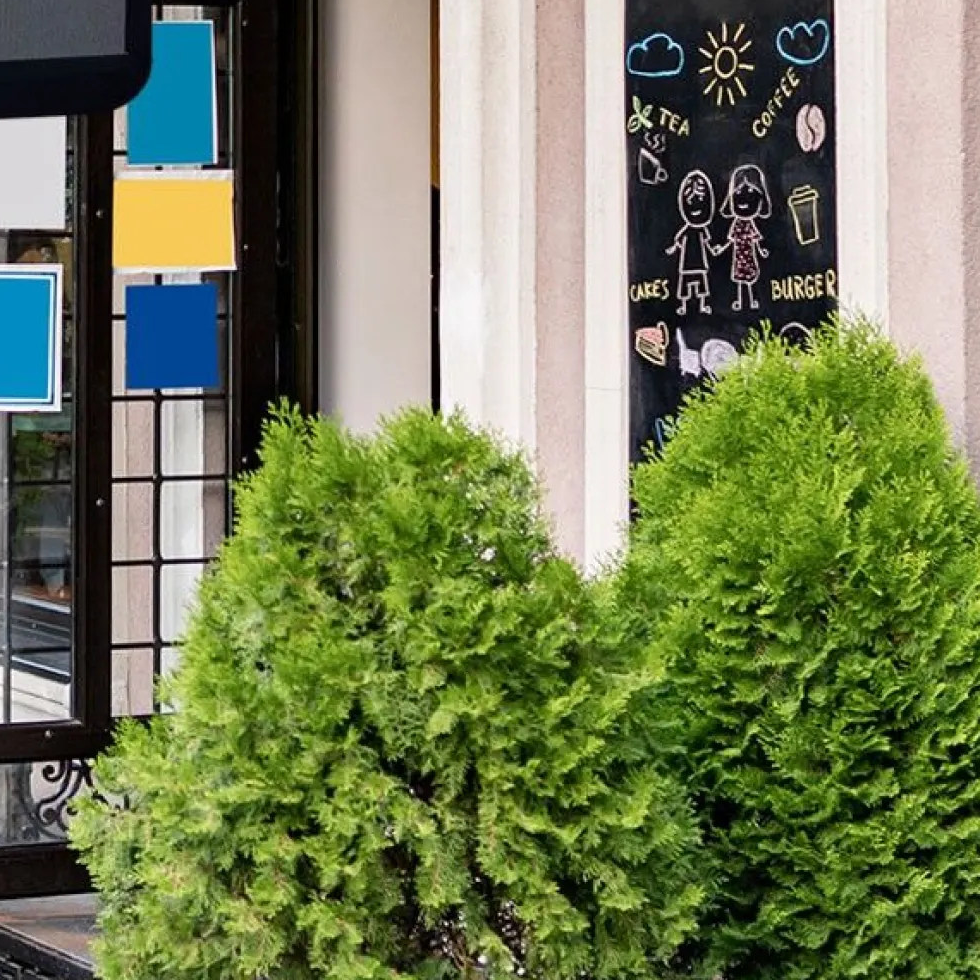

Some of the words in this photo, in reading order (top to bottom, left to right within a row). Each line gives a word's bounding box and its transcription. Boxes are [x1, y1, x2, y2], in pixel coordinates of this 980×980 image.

[752, 66, 801, 138] COFFEE
[658, 106, 691, 137] TEA
[629, 279, 671, 303] CAKES
[770, 269, 838, 302] BURGER
